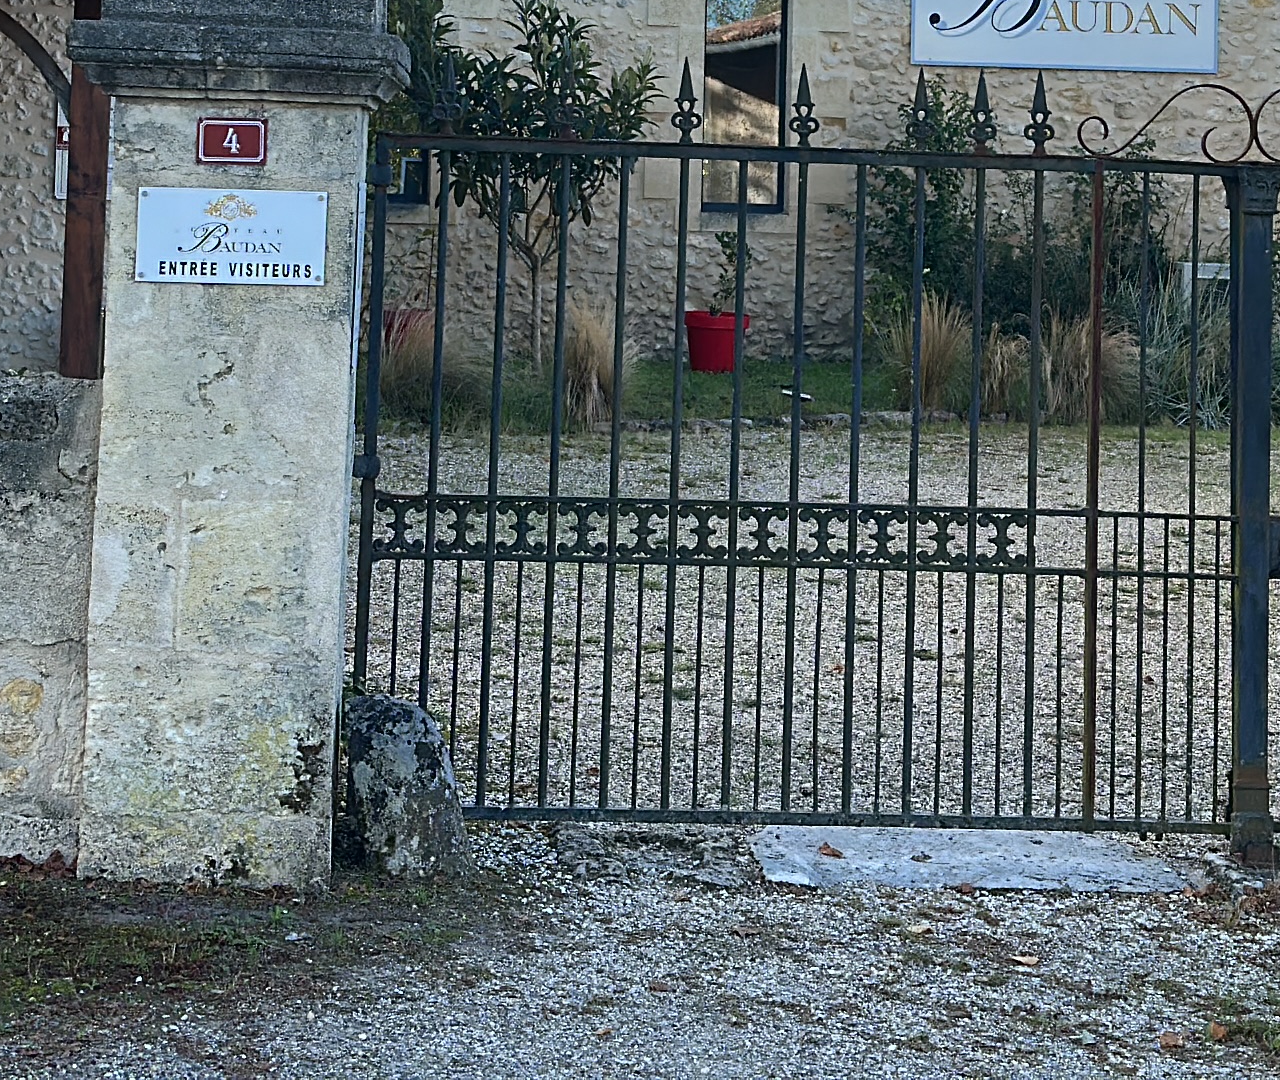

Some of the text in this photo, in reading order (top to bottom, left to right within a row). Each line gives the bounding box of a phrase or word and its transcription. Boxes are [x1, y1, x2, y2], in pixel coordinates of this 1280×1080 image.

[222, 127, 240, 154] 4
[177, 221, 282, 255] BAUDAN
[158, 258, 312, 279] ENTRÉE VISITEURS
